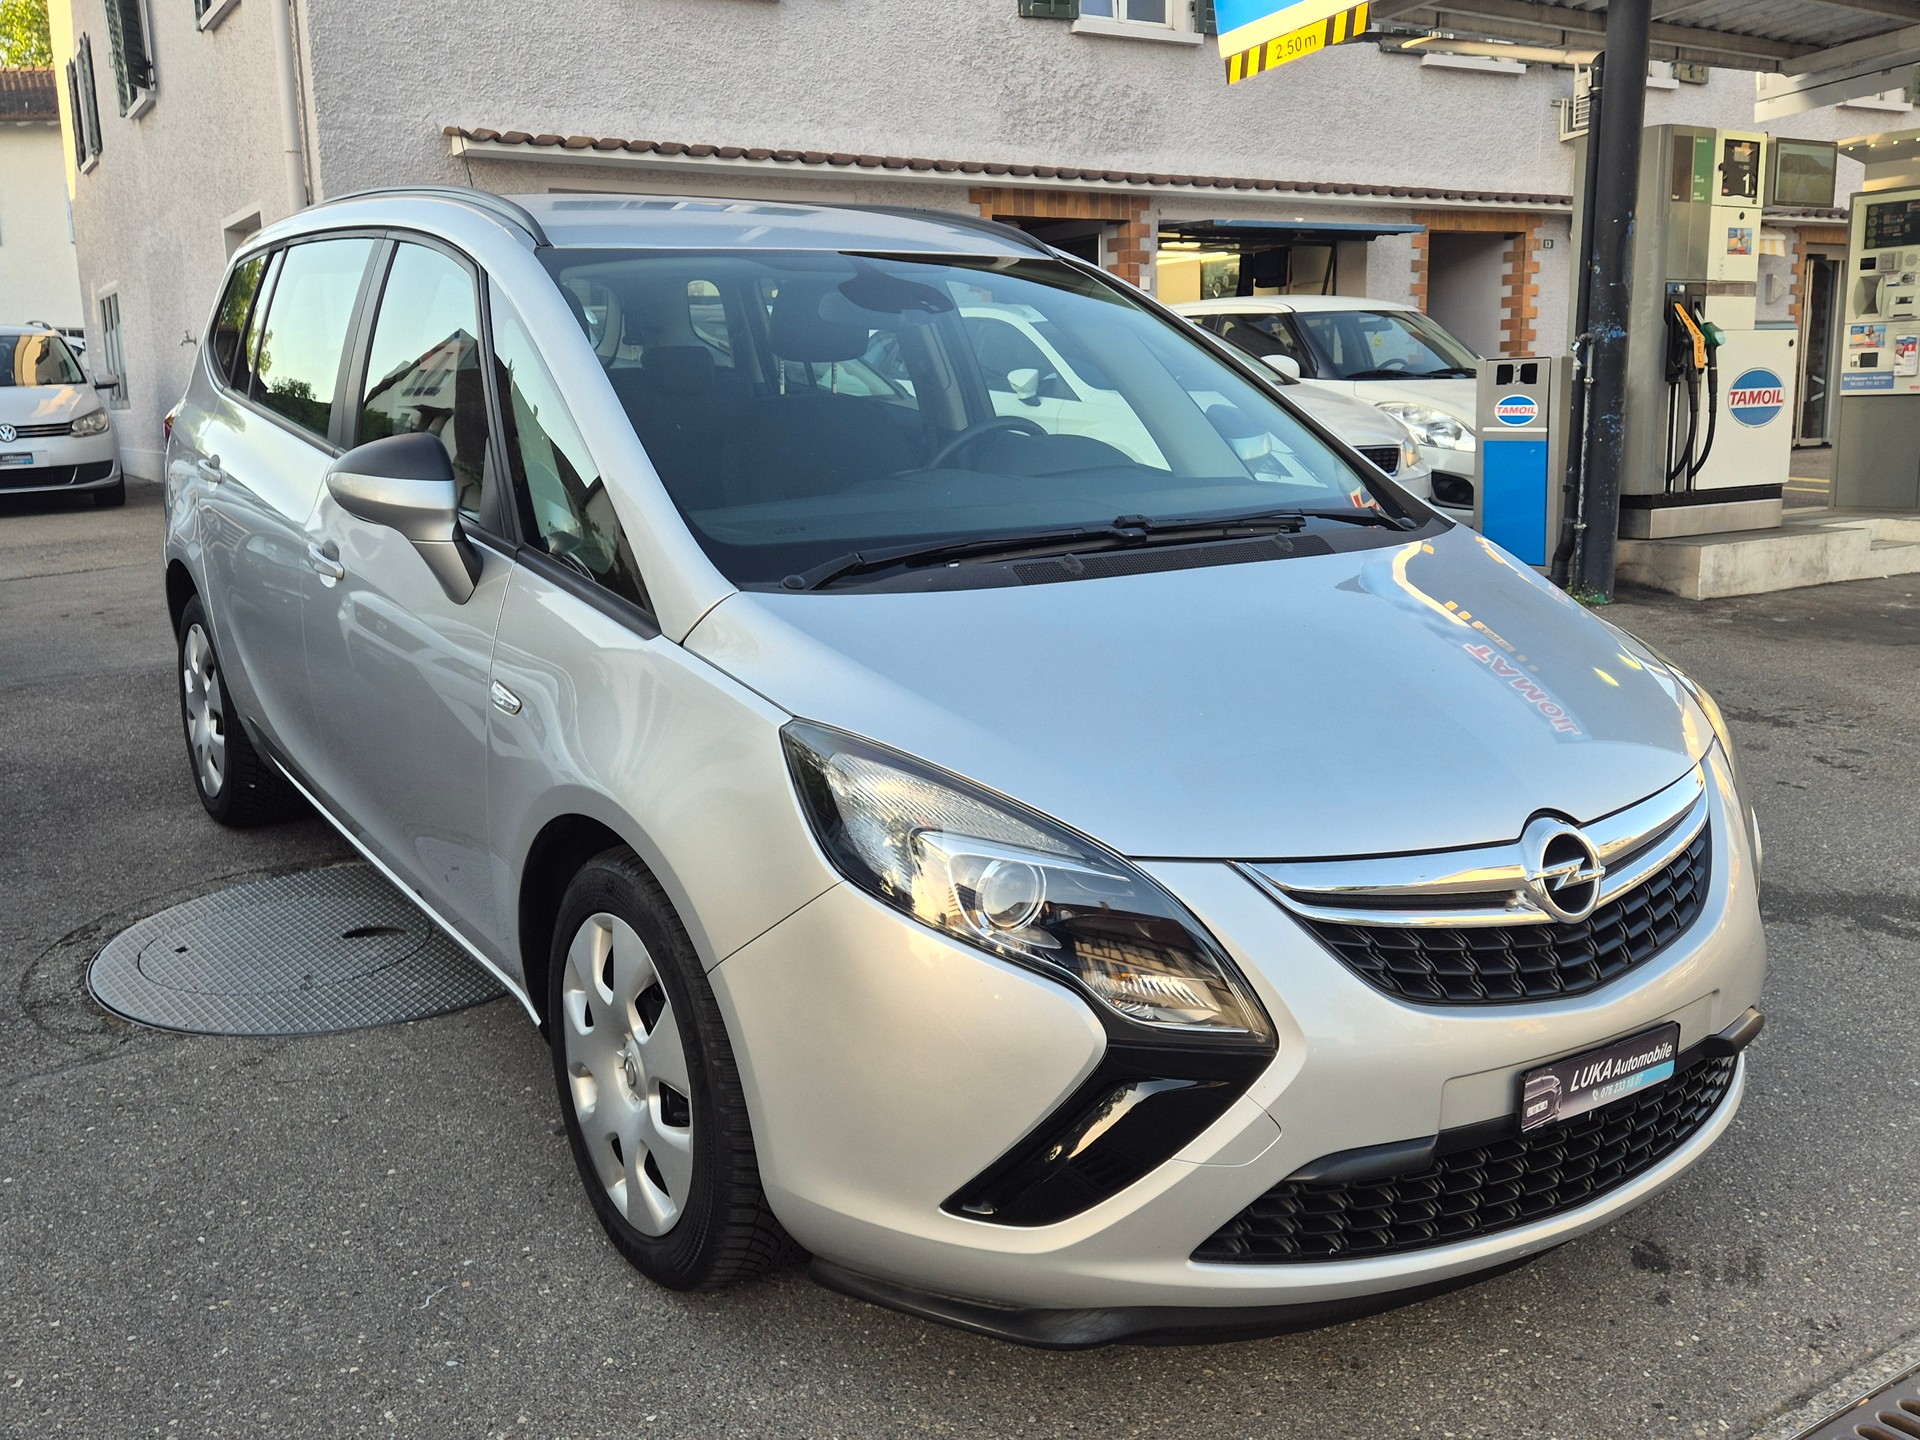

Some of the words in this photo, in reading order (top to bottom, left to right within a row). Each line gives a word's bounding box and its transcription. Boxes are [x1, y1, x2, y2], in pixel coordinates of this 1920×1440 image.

[1275, 36, 1302, 60] 2.50
[1305, 34, 1316, 49] m
[1742, 173, 1750, 195] 1
[1730, 390, 1784, 406] TAMOIL
[1496, 406, 1537, 415] TAMOIL
[1570, 1058, 1613, 1093] LUKA
[1612, 1042, 1673, 1077] Automobile
[1600, 1084, 1614, 1099] 076
[1613, 1080, 1627, 1094] 233
